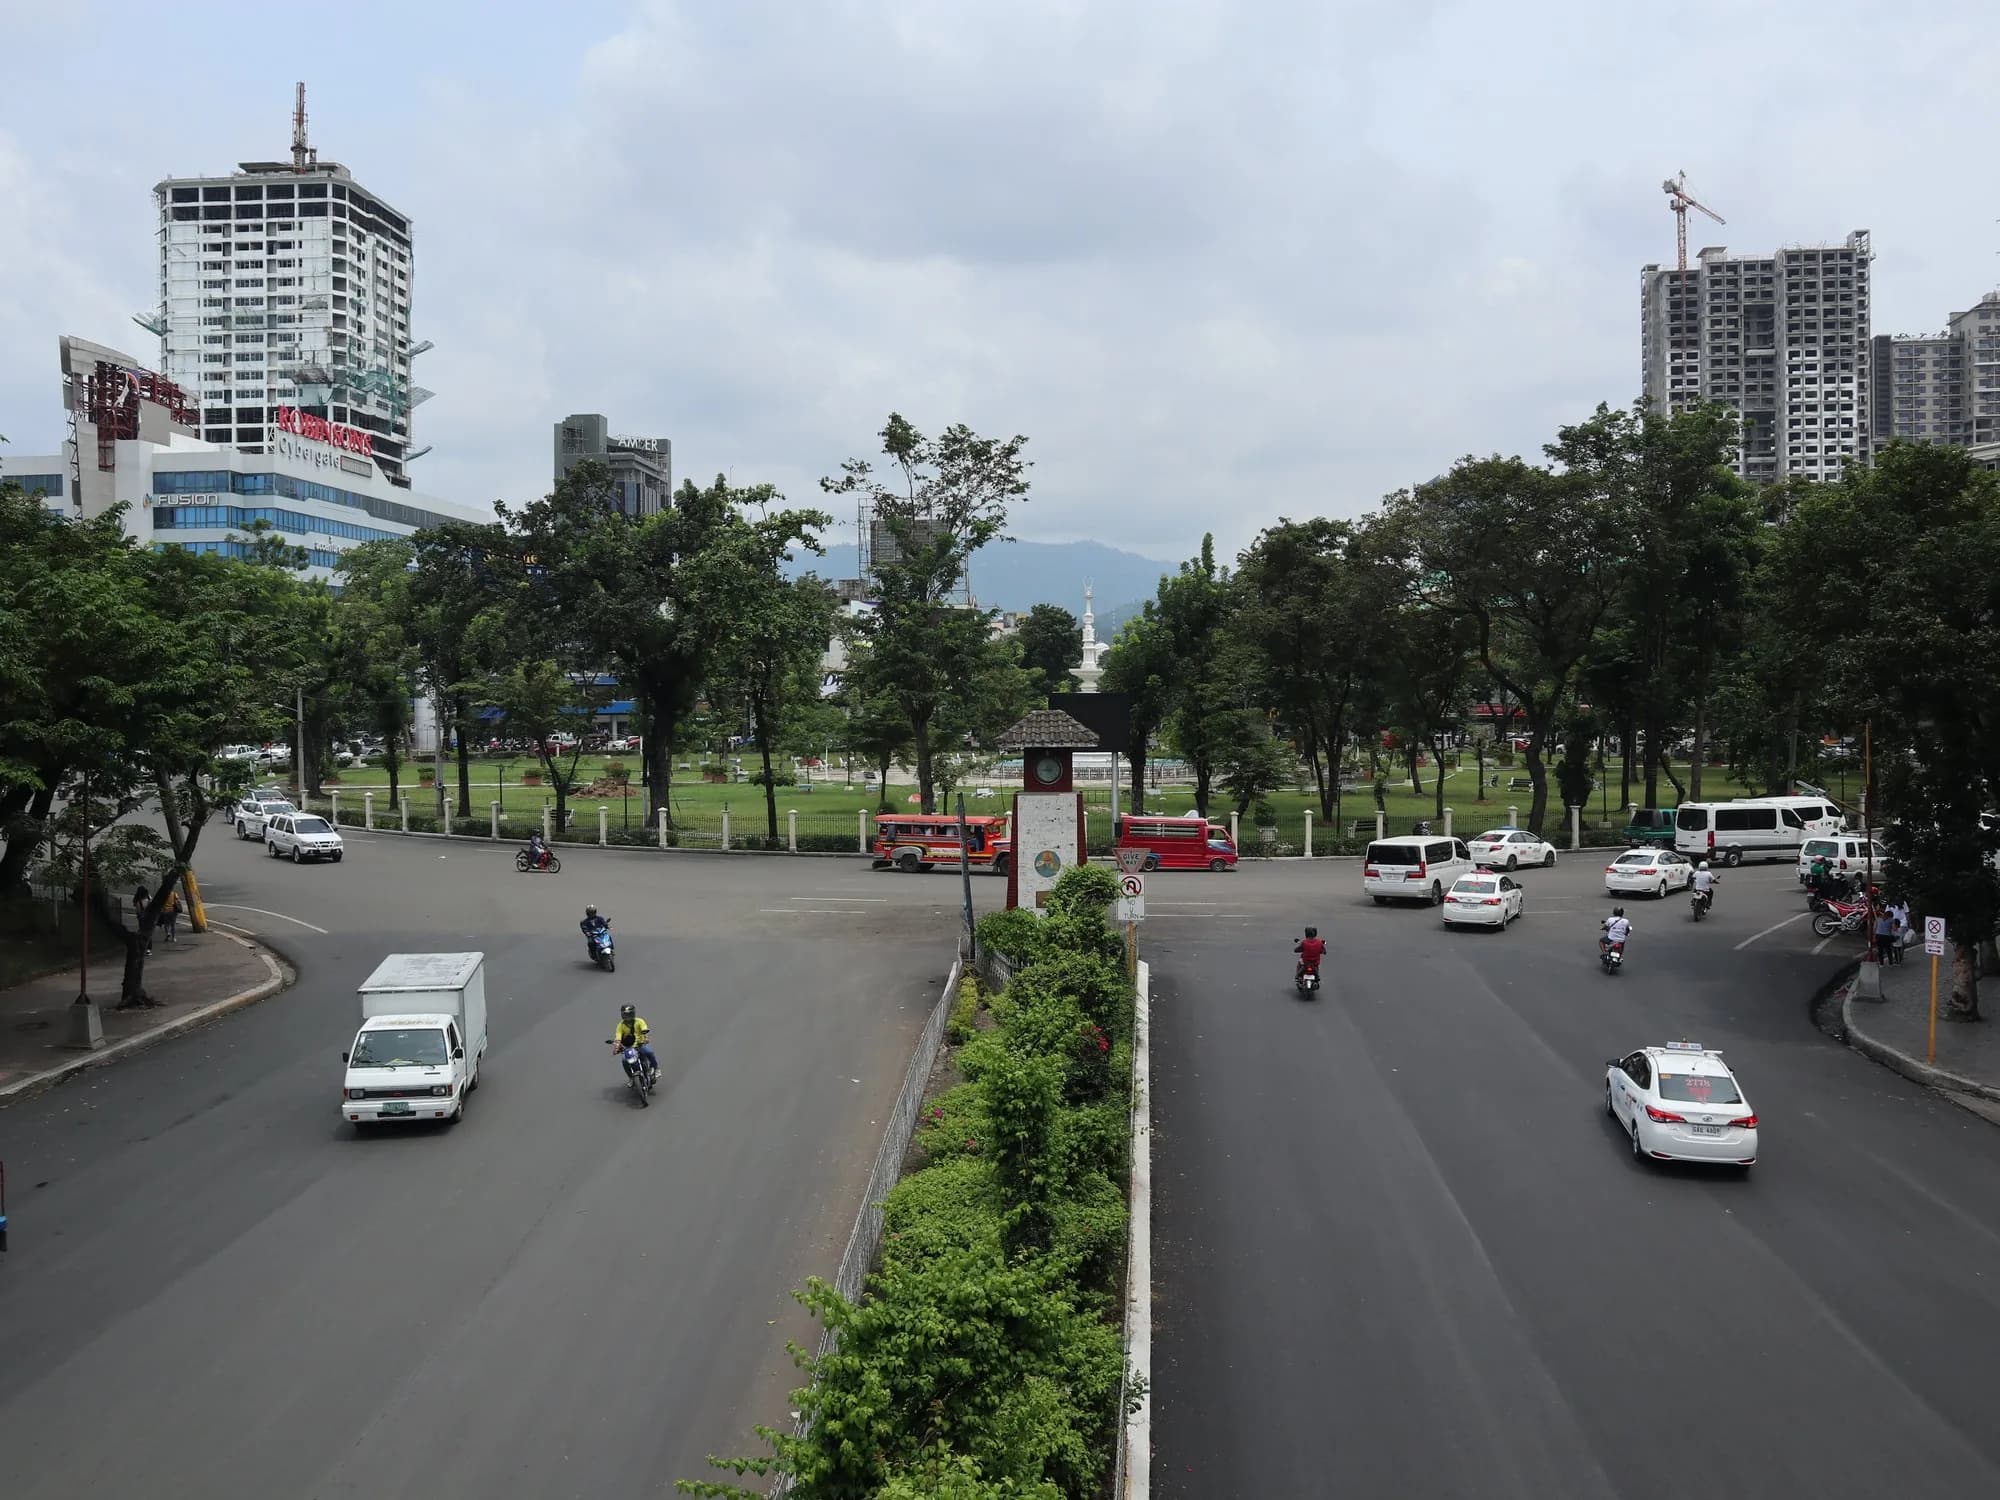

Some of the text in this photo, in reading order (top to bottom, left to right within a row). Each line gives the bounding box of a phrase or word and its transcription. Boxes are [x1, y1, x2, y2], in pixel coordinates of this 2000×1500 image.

[278, 404, 373, 457] ROBINSONS
[280, 437, 340, 468] Cybergate
[158, 494, 218, 505] FUSION
